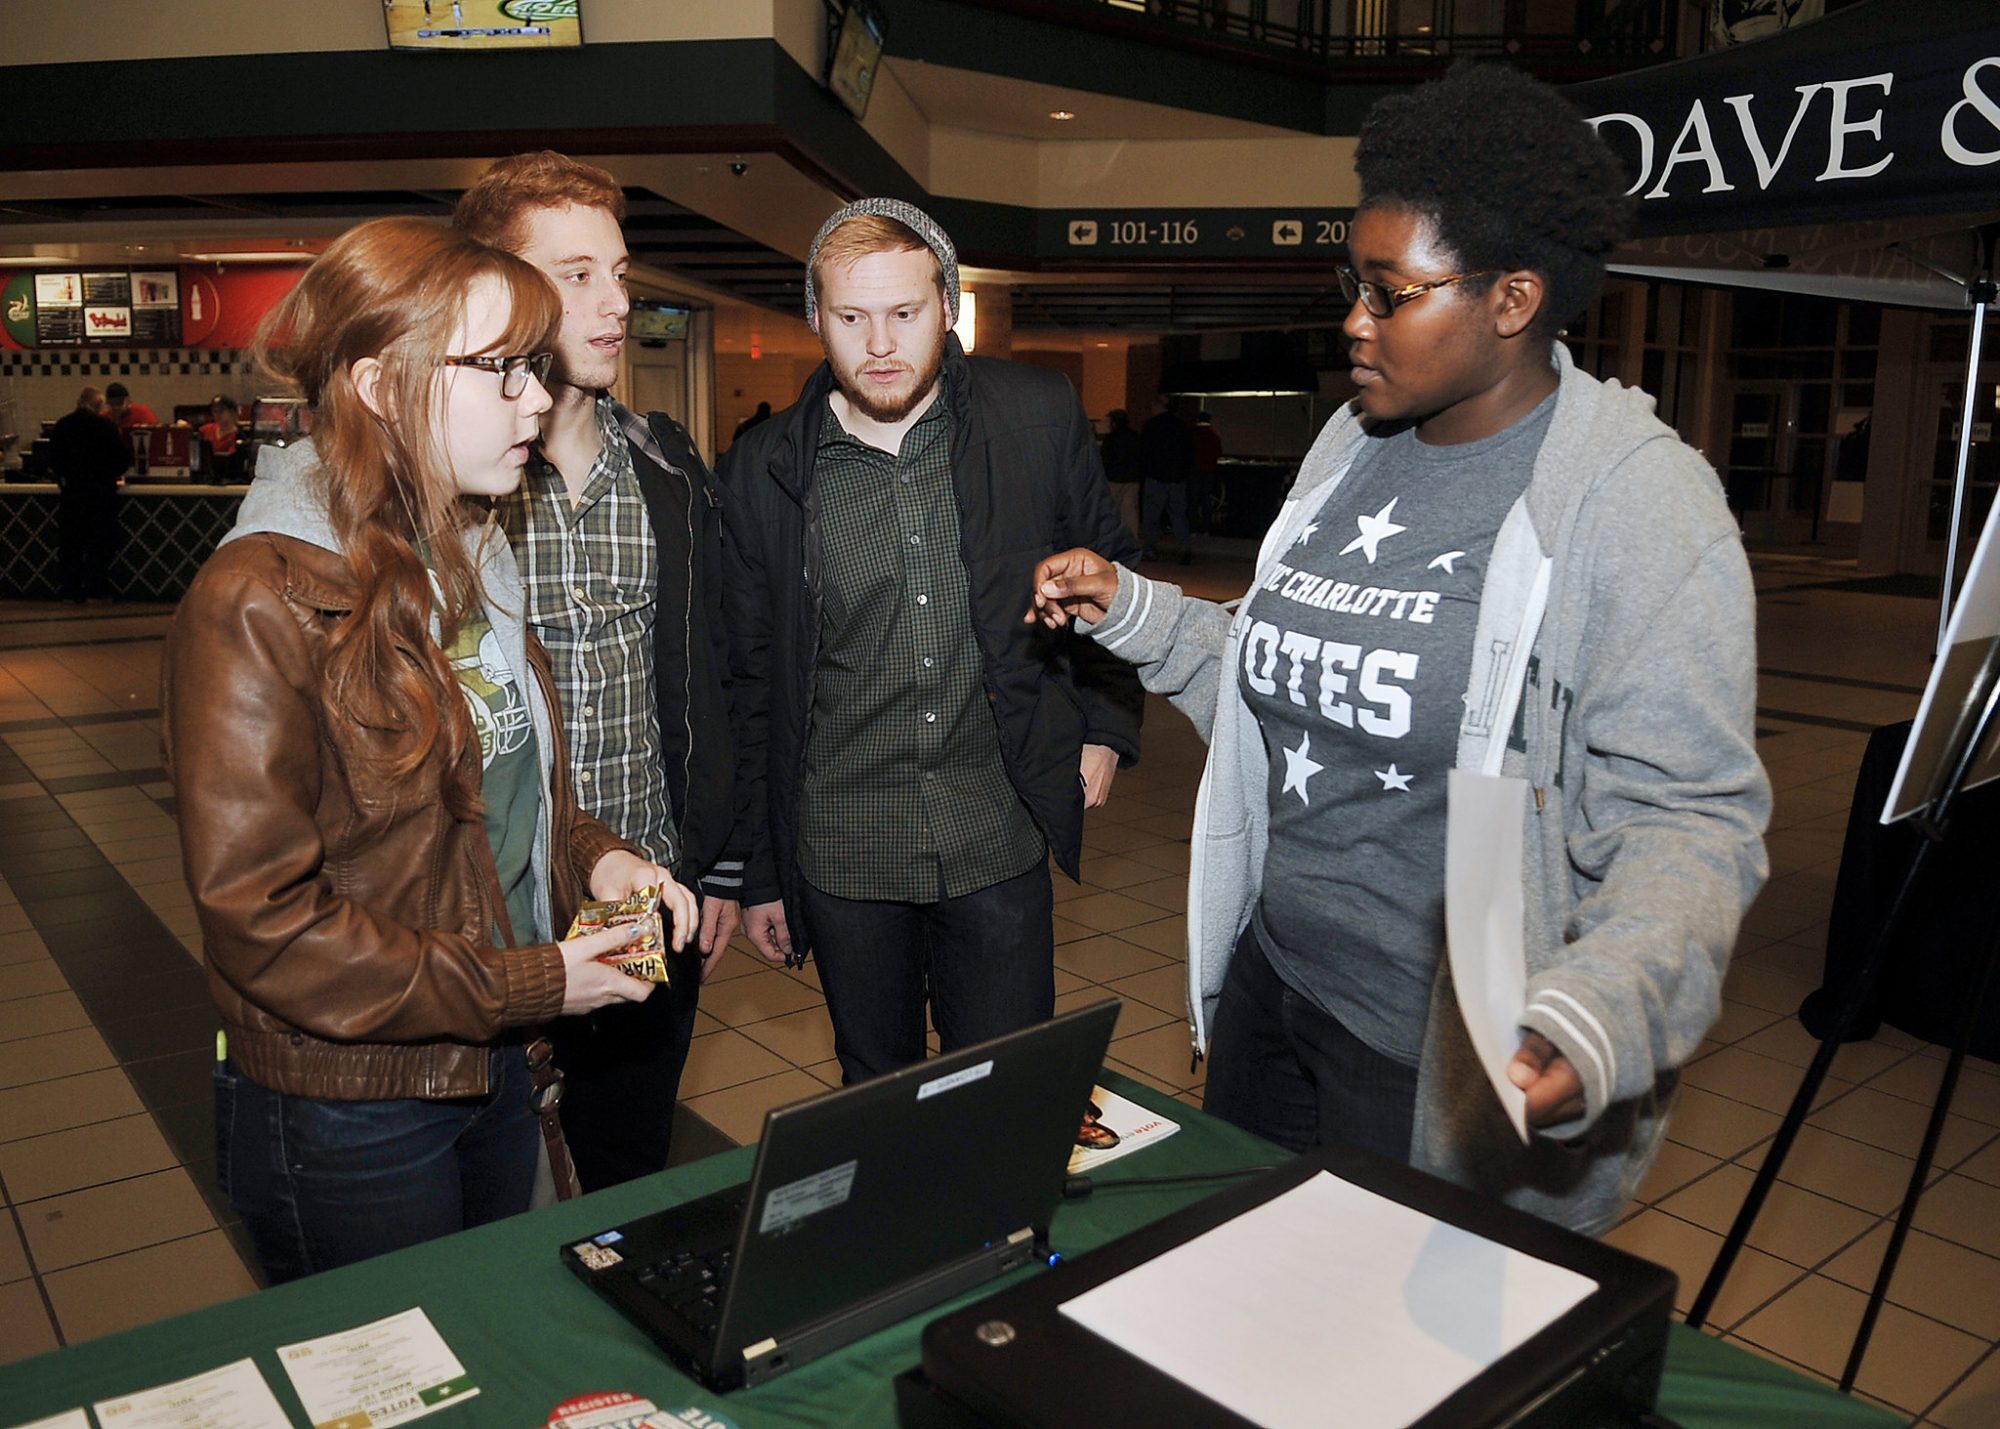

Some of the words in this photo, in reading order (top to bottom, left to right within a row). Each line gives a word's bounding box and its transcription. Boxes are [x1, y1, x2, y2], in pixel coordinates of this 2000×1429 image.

[1582, 72, 1894, 200] DAVE
[1940, 56, 2000, 166] &
[1110, 219, 1199, 245] 101-116
[1280, 570, 1441, 624] CHARLOTTE
[557, 1392, 634, 1417] REGISTER
